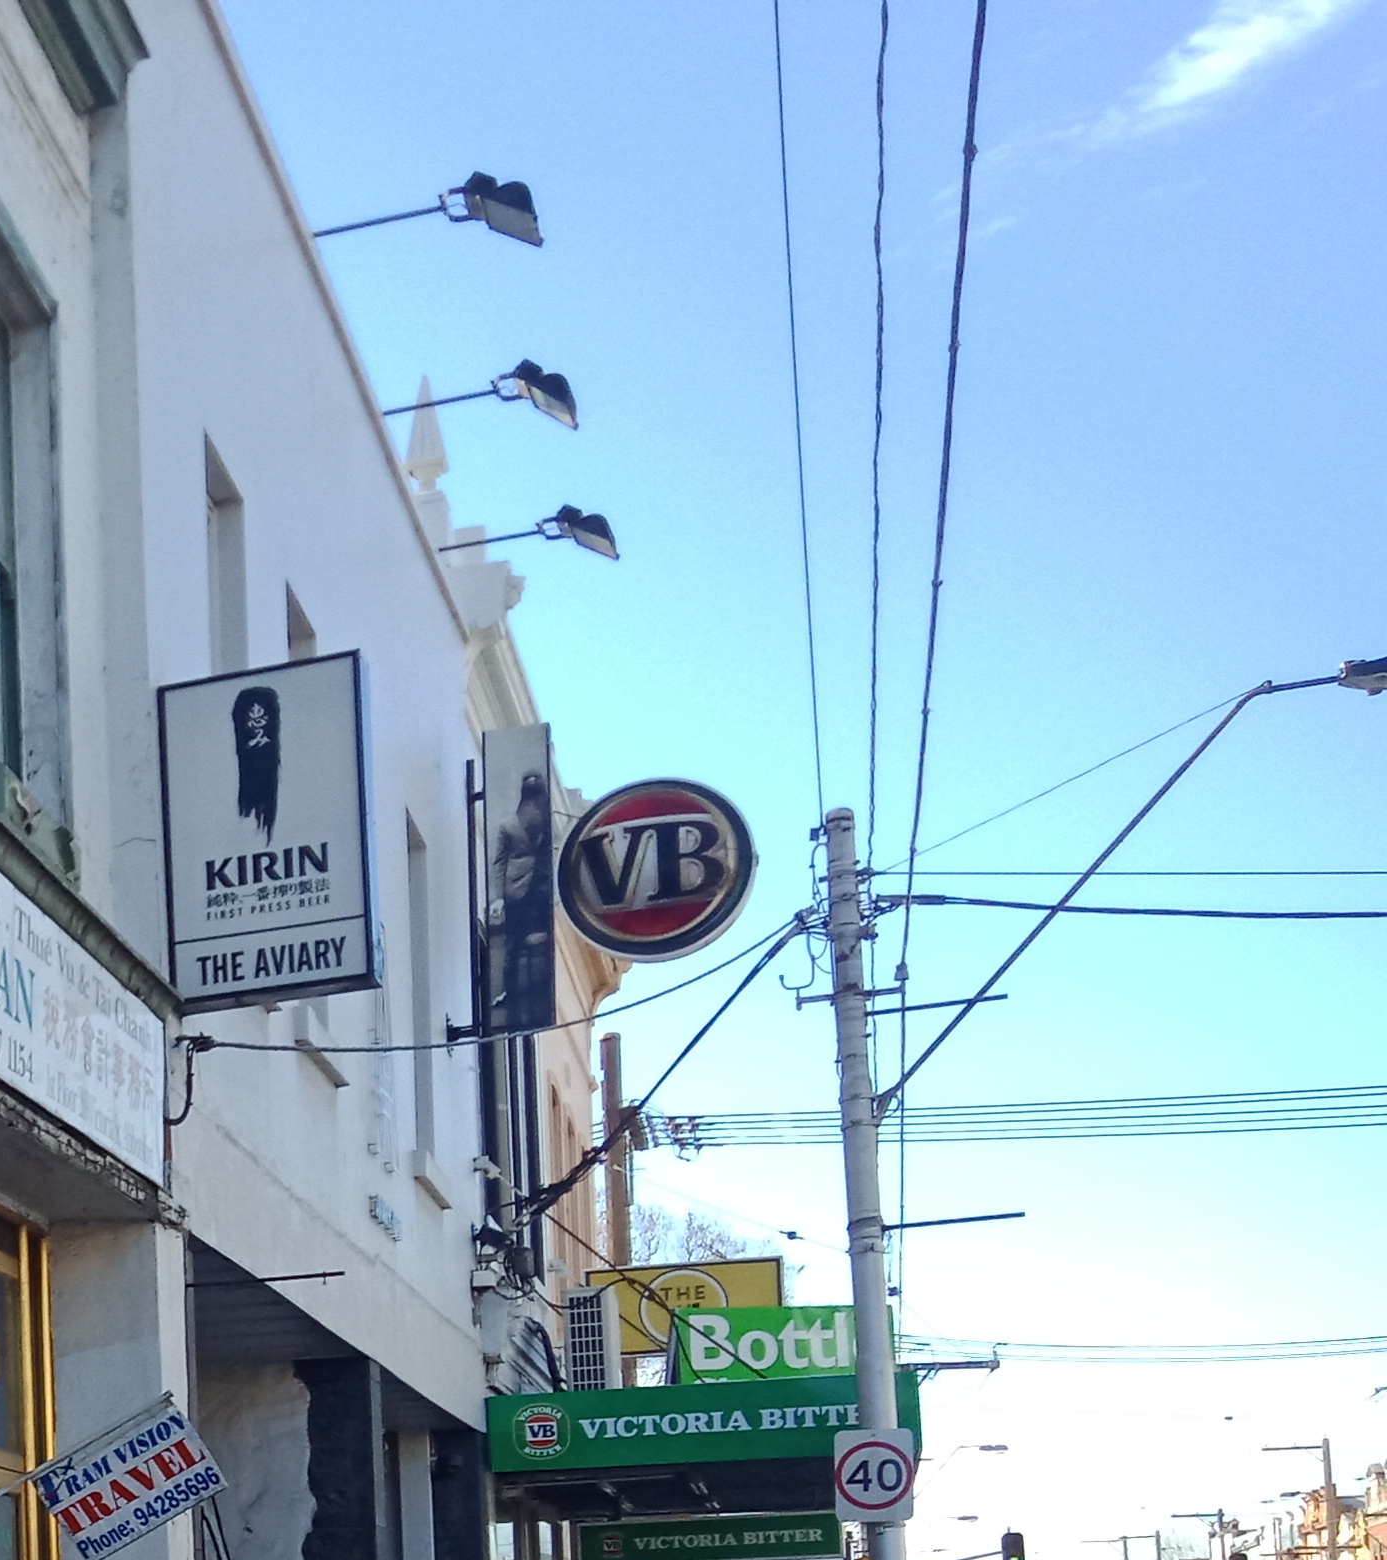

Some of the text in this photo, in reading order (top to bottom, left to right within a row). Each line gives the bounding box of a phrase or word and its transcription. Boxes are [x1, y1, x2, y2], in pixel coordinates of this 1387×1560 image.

[206, 841, 329, 891] KIRIN
[577, 818, 729, 912] VB
[207, 894, 330, 921] FIRST PRESS BEER
[196, 935, 346, 986] THE AVIARY
[7, 1035, 34, 1084] 1154
[660, 1285, 705, 1301] THE
[689, 1311, 857, 1371] Bottl
[113, 1411, 186, 1465] VISION
[517, 1406, 562, 1421] VICTORIA
[528, 1423, 556, 1438] VB
[579, 1404, 860, 1440] VICTORIA BITTE
[54, 1438, 206, 1536] TRAVEL
[845, 1459, 902, 1492] 40
[76, 1466, 220, 1559] Phone: 94285696
[633, 1532, 737, 1551] VICTORIA
[743, 1528, 824, 1546] BITTER
